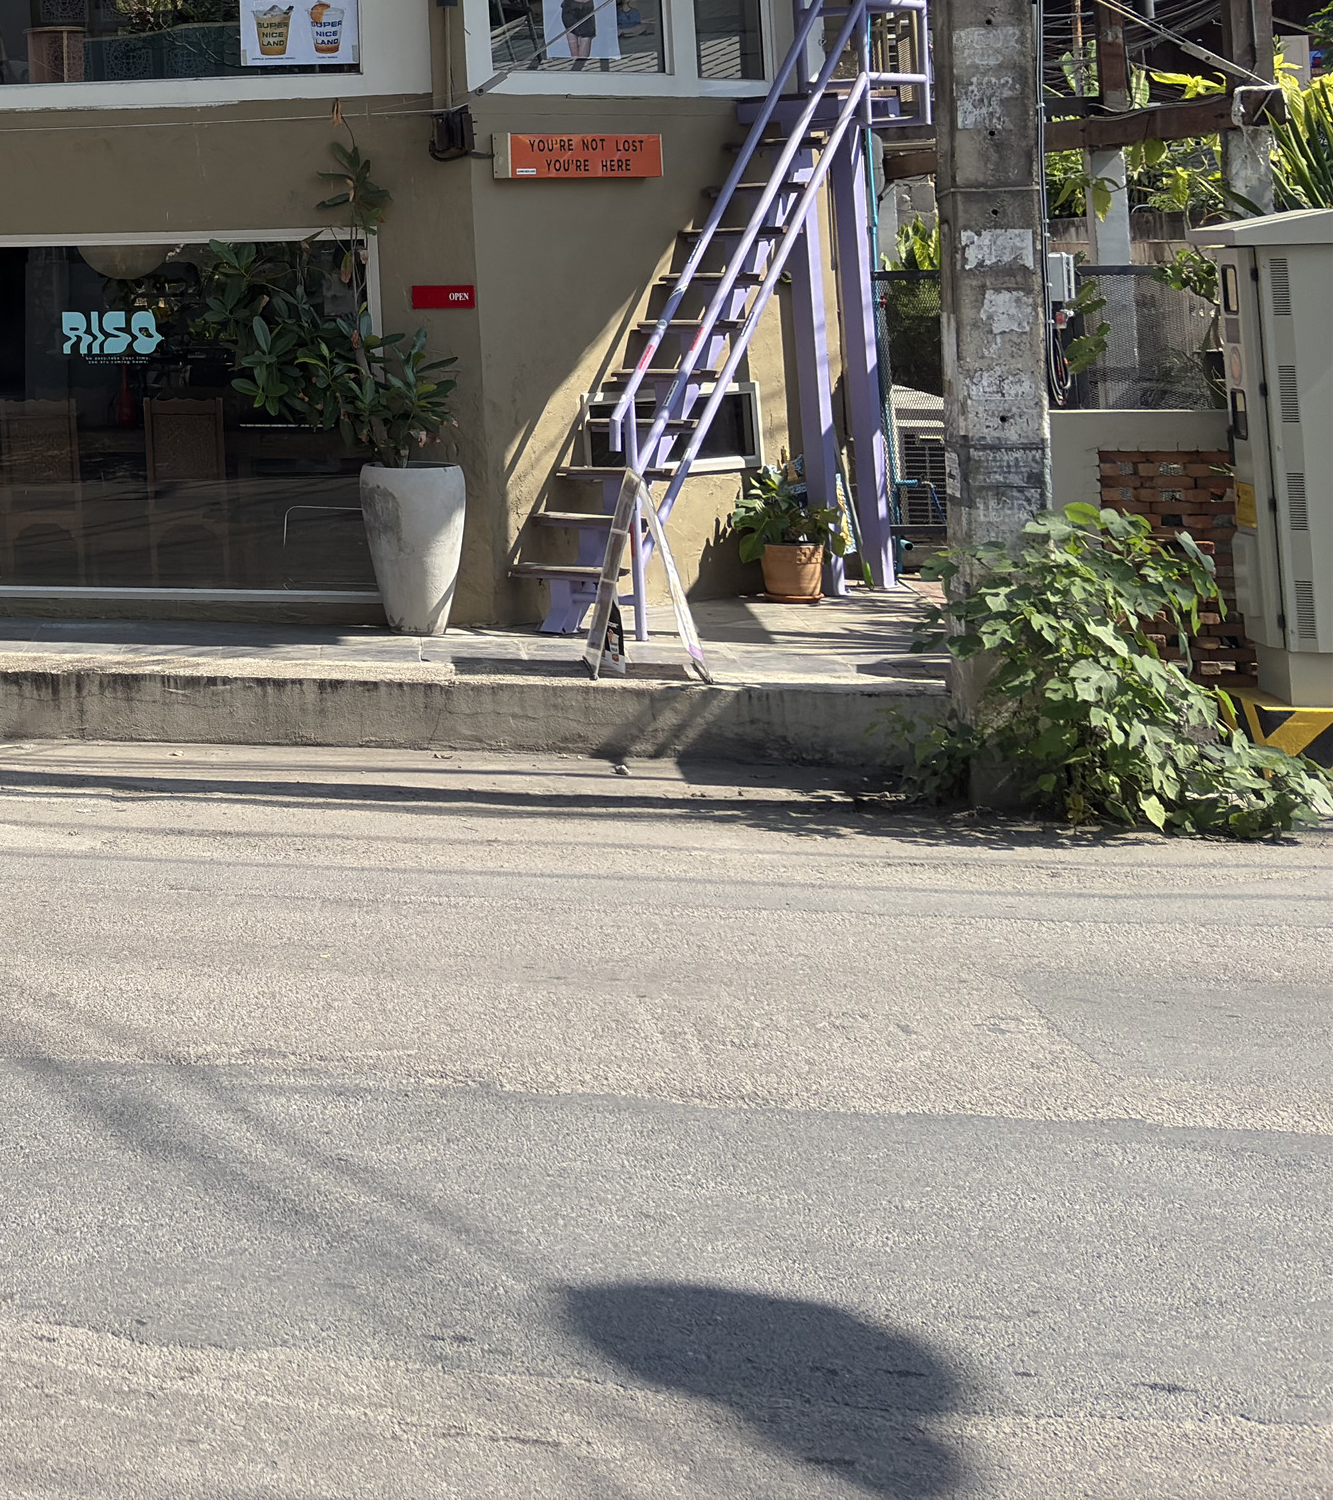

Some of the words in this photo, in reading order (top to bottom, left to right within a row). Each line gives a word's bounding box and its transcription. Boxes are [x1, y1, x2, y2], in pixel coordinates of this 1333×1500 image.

[528, 138, 574, 152] YOU'RE
[582, 138, 606, 151] NOT
[616, 140, 644, 152] LOST
[545, 159, 590, 172] YOU'RE
[602, 158, 631, 172] HERE
[448, 292, 470, 301] OPEN
[62, 311, 165, 354] RISO
